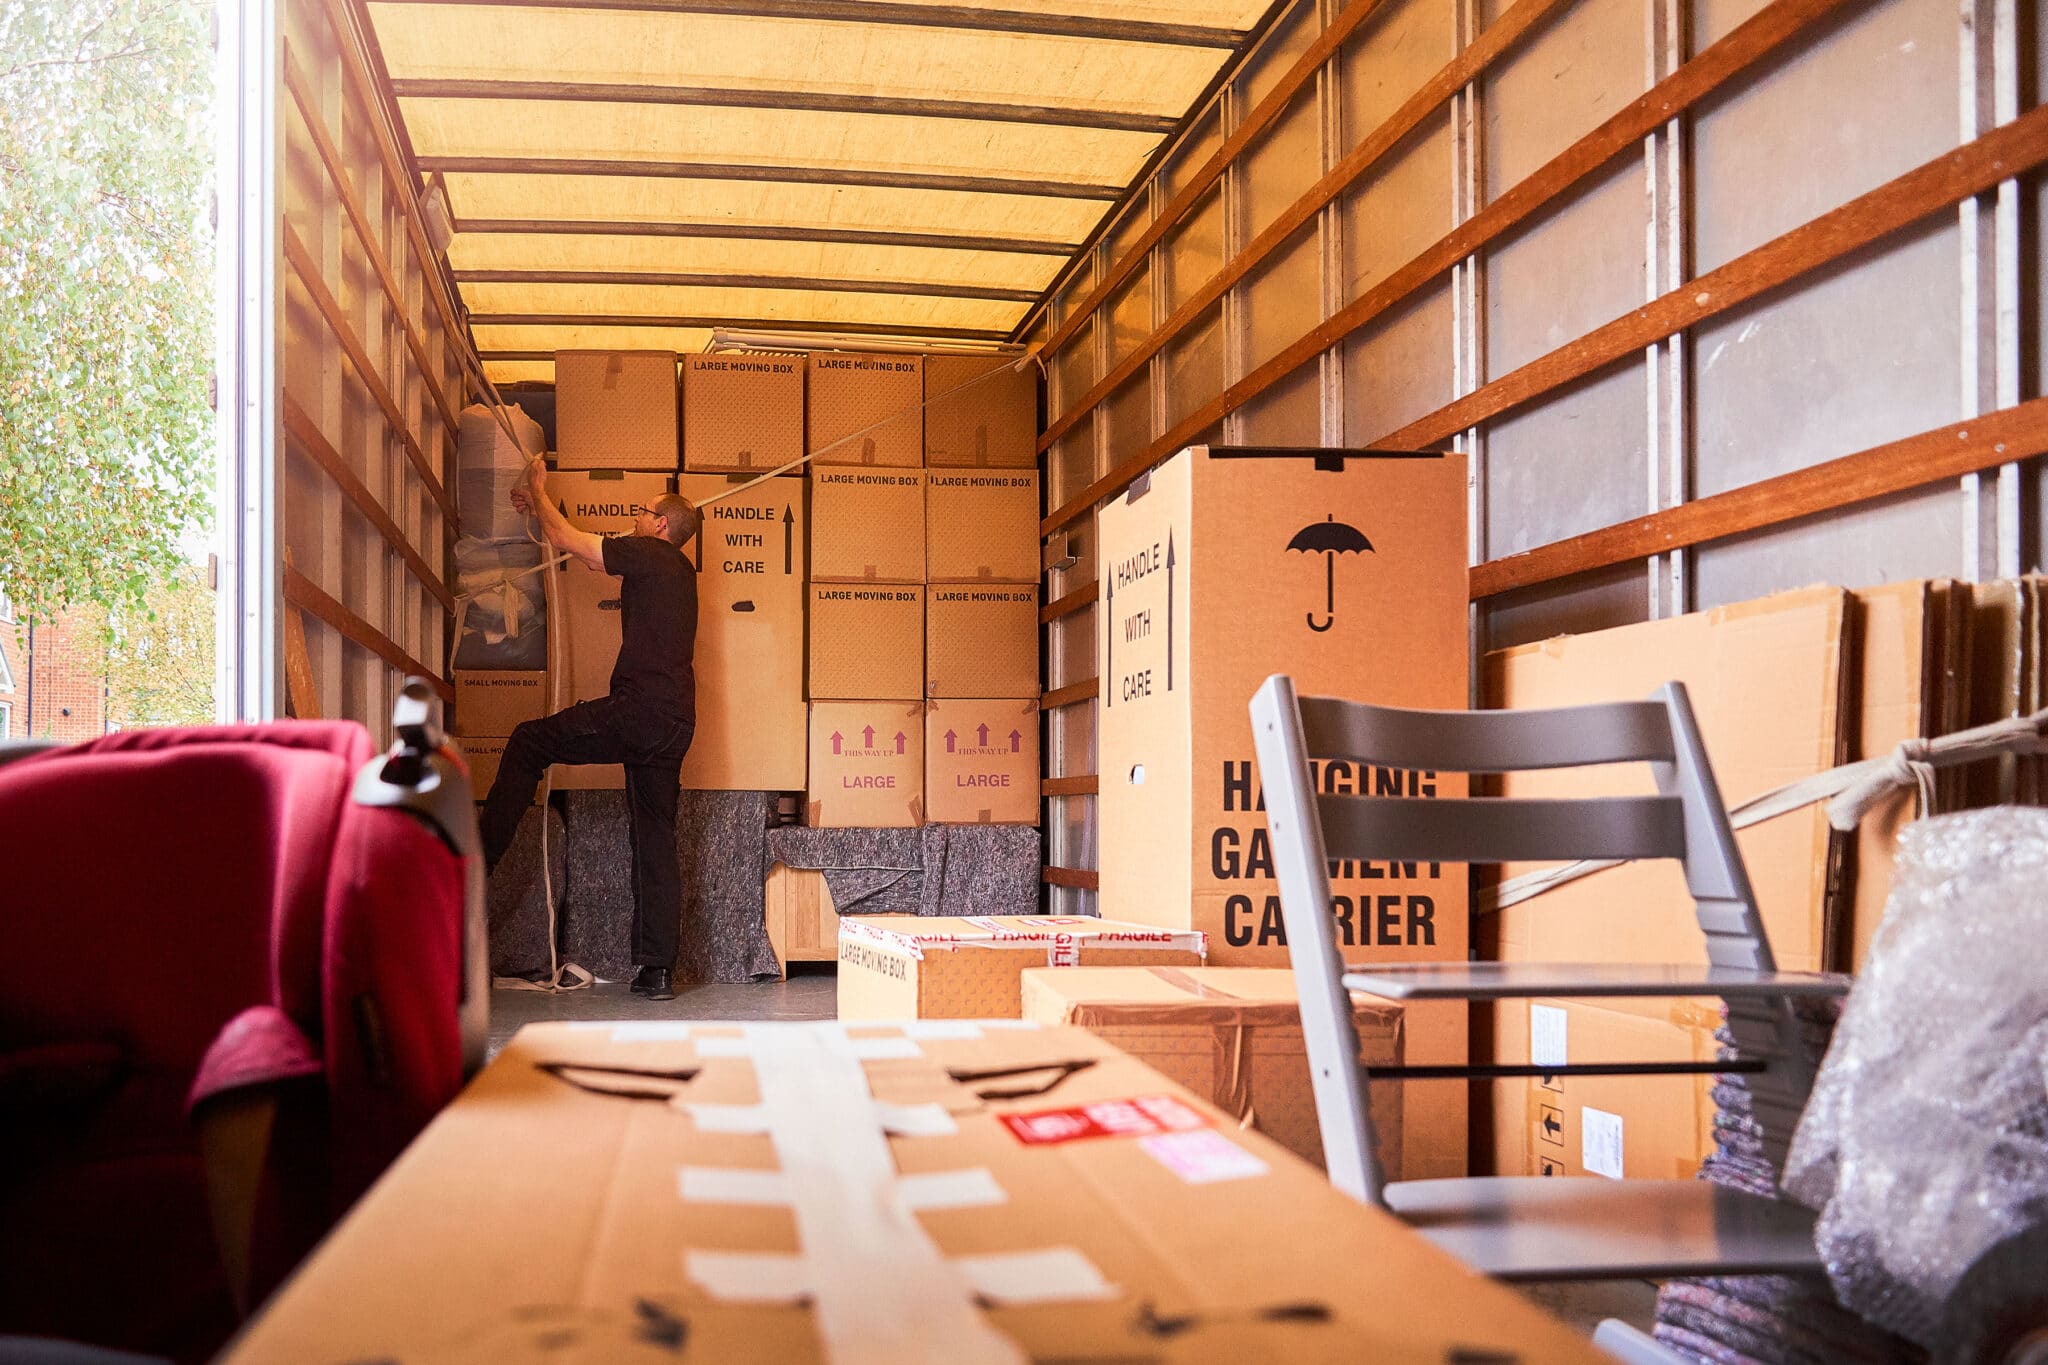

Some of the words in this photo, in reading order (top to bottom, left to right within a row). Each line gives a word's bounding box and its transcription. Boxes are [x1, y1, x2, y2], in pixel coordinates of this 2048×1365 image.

[694, 361, 728, 371] LARGE
[731, 362, 771, 372] MOVING
[773, 364, 794, 374] BOX
[818, 359, 852, 369] LARGE
[896, 363, 916, 373] BOX
[821, 474, 854, 484] LARGE
[857, 475, 896, 485] MOVING
[899, 476, 919, 486] BOX
[935, 477, 969, 486] LARGE
[971, 477, 1008, 487] MOVING
[1011, 478, 1031, 487] BOX
[577, 504, 639, 517] HANDLE
[713, 506, 775, 521] HANDLE
[725, 534, 763, 547] WITH
[722, 560, 765, 574] CARE
[1118, 543, 1160, 589] HANDLE
[818, 591, 852, 601] LARGE
[854, 591, 893, 601] MOVING
[896, 592, 916, 602] BOX
[936, 592, 969, 602] LARGE
[972, 593, 1009, 602] MOVING
[1012, 593, 1032, 602] BOX
[1124, 608, 1151, 643] WITH
[464, 679, 490, 687] SMALL
[492, 679, 521, 687] MOVING
[1123, 669, 1152, 702] CARE
[979, 748, 998, 756] WAY
[843, 775, 896, 789] LARGE
[957, 774, 1010, 787] LARGE
[1224, 760, 1437, 811] HGING
[1225, 895, 1437, 946] CARIER
[841, 941, 861, 965] LARGE
[862, 948, 888, 974] MOVING
[890, 957, 907, 981] BOX
